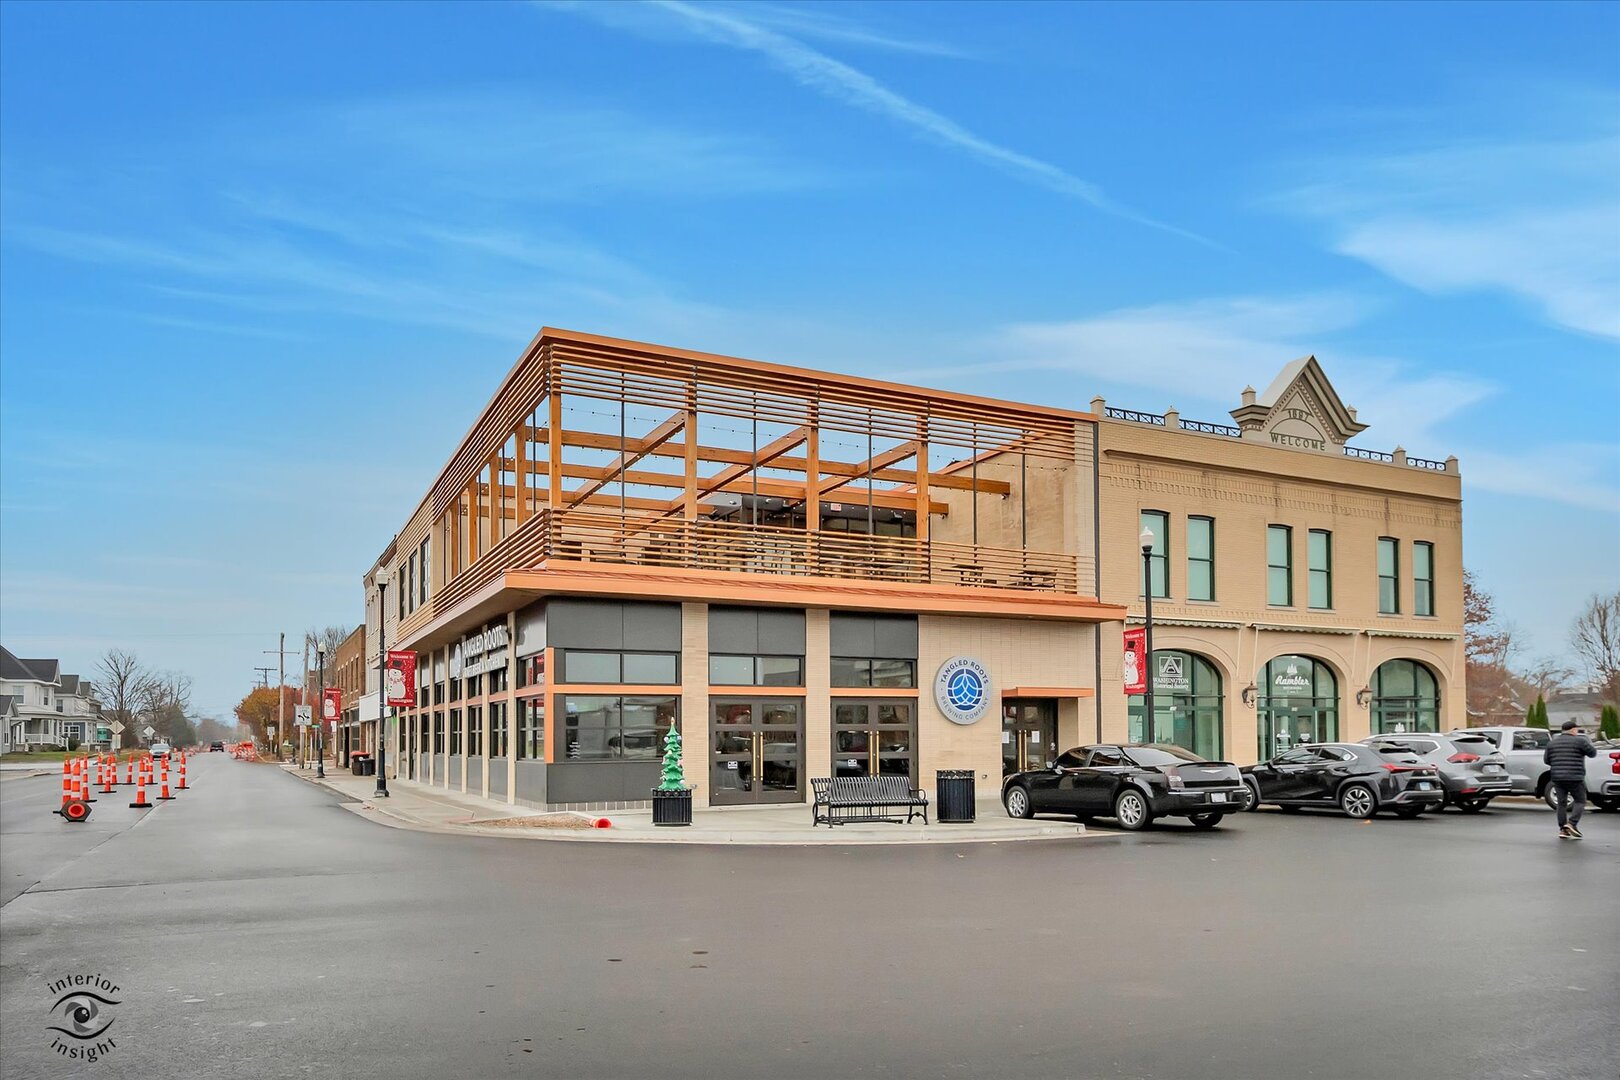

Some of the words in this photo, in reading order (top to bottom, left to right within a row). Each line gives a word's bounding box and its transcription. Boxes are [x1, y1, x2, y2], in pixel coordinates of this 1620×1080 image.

[1270, 434, 1325, 451] WELCOME
[462, 634, 484, 659] TANGLED
[484, 625, 504, 650] ROOTS
[941, 660, 968, 683] TANGLED
[970, 661, 989, 684] ROOTS
[941, 696, 963, 720] BREWING
[965, 698, 989, 720] COMPANY
